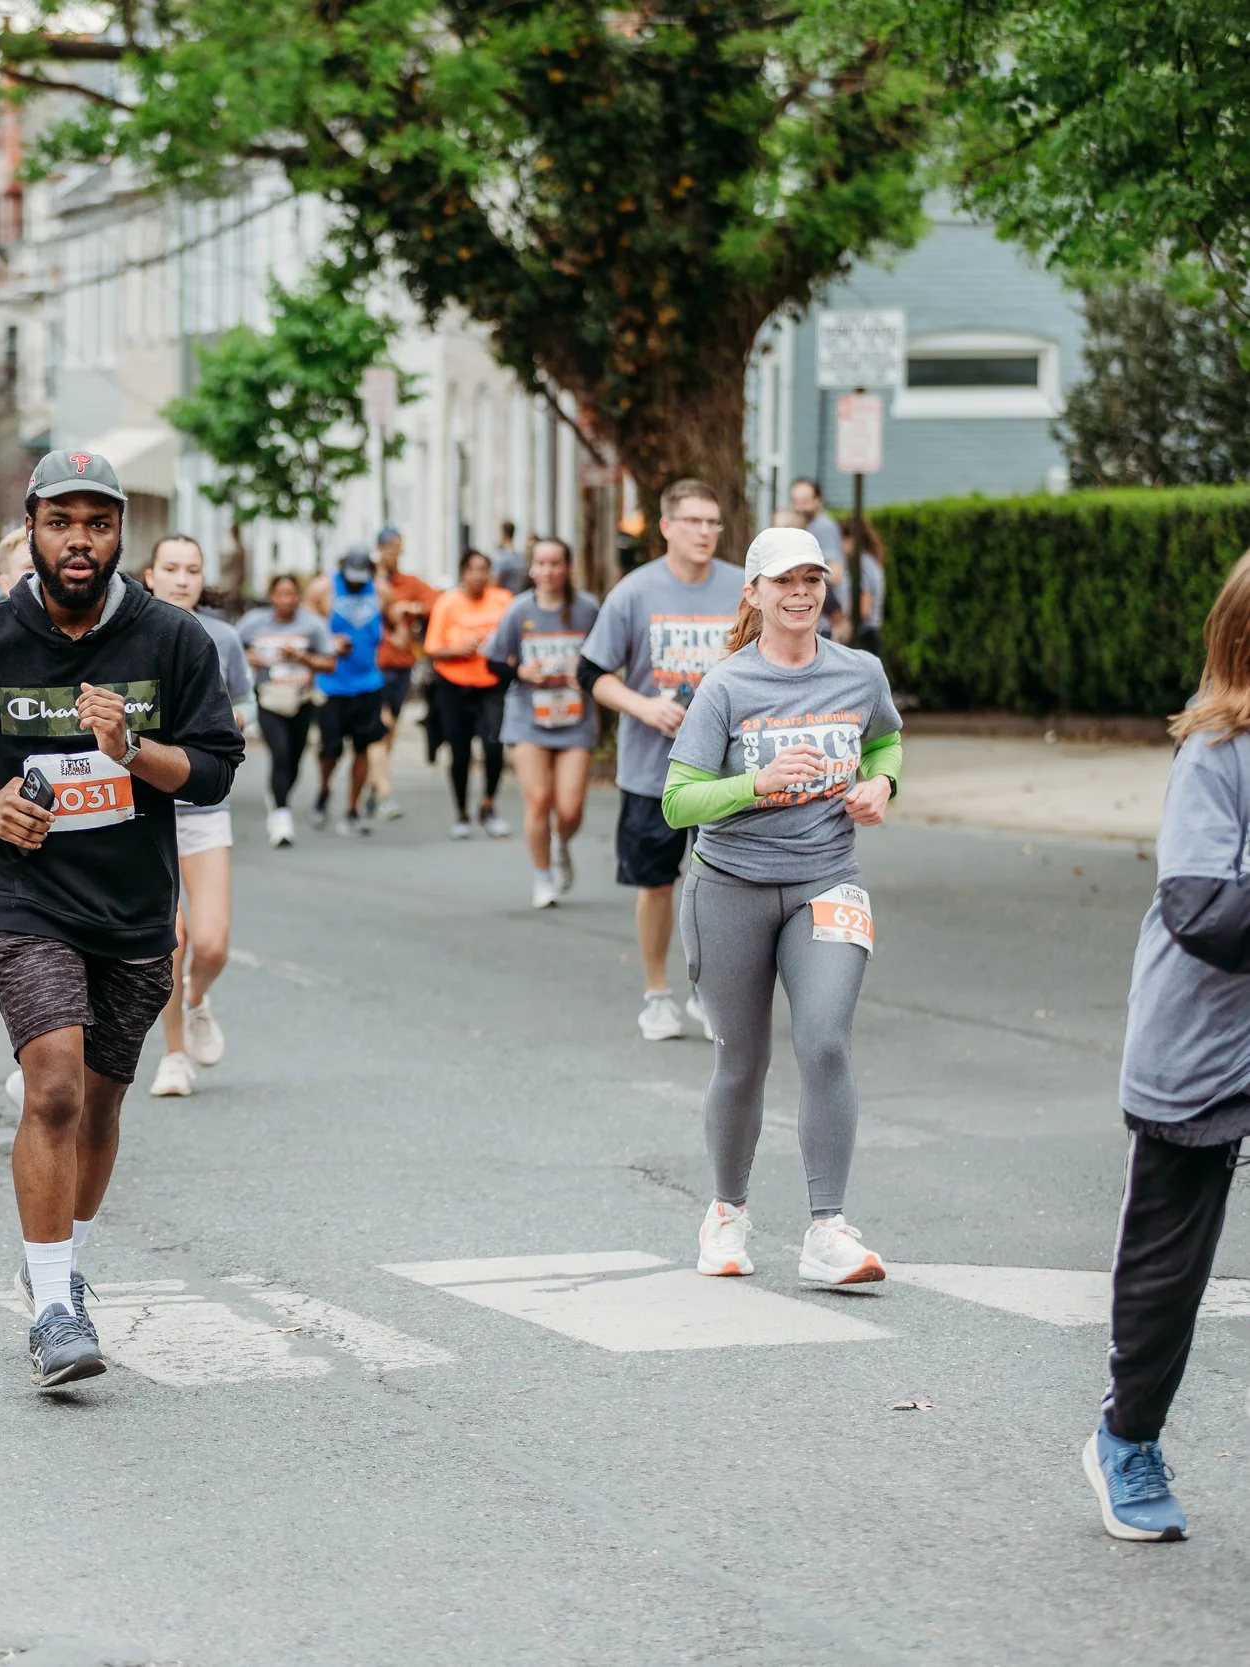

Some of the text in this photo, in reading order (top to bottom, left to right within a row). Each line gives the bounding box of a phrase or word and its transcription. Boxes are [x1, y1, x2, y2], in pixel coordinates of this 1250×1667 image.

[70, 452, 92, 474] P
[7, 697, 154, 721] Chaon
[742, 718, 761, 731] 28
[765, 716, 802, 728] Years
